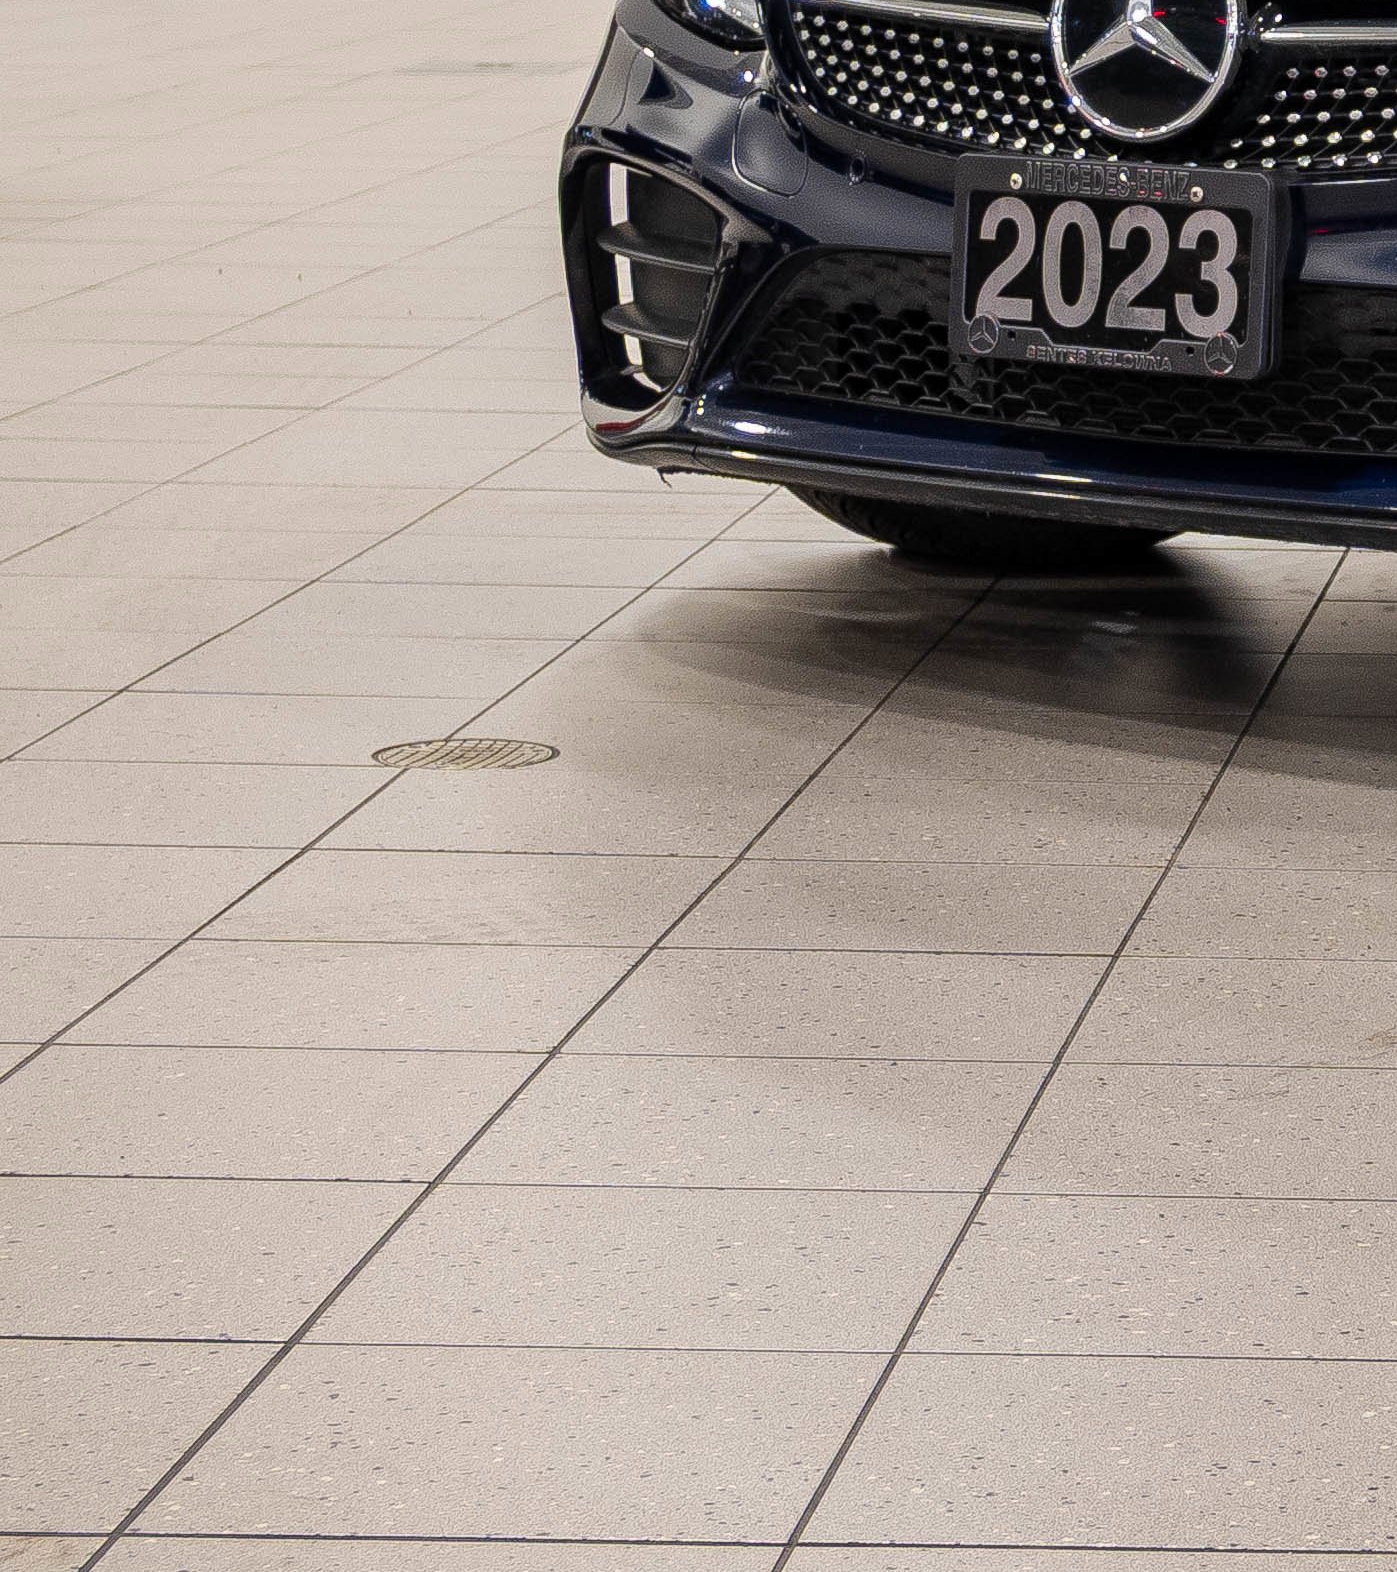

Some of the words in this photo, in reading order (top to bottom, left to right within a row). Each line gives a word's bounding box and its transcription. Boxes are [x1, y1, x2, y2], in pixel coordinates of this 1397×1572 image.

[1025, 160, 1191, 200] MERCEDES-BENZ
[975, 196, 1238, 339] 2023
[1092, 350, 1173, 372] KELOWNA
